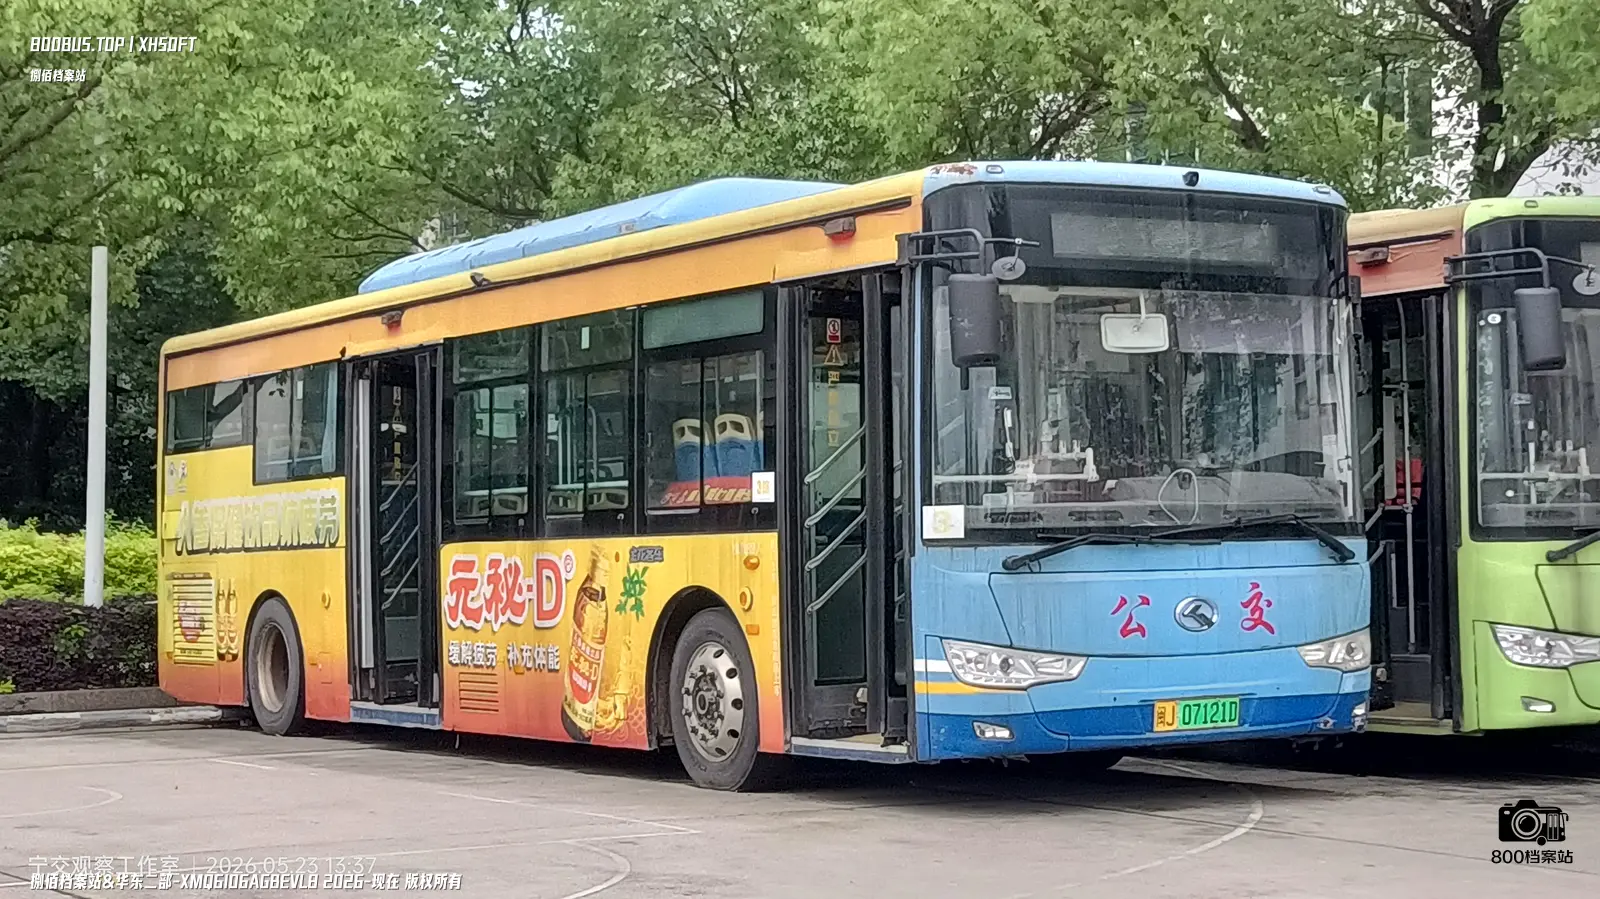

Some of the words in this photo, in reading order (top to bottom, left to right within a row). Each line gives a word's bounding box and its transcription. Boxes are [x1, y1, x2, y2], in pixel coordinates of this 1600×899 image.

[1110, 594, 1151, 639] 公
[1239, 581, 1276, 636] 交
[448, 640, 498, 669] 缓解疲劳
[507, 641, 560, 672] 补充体能
